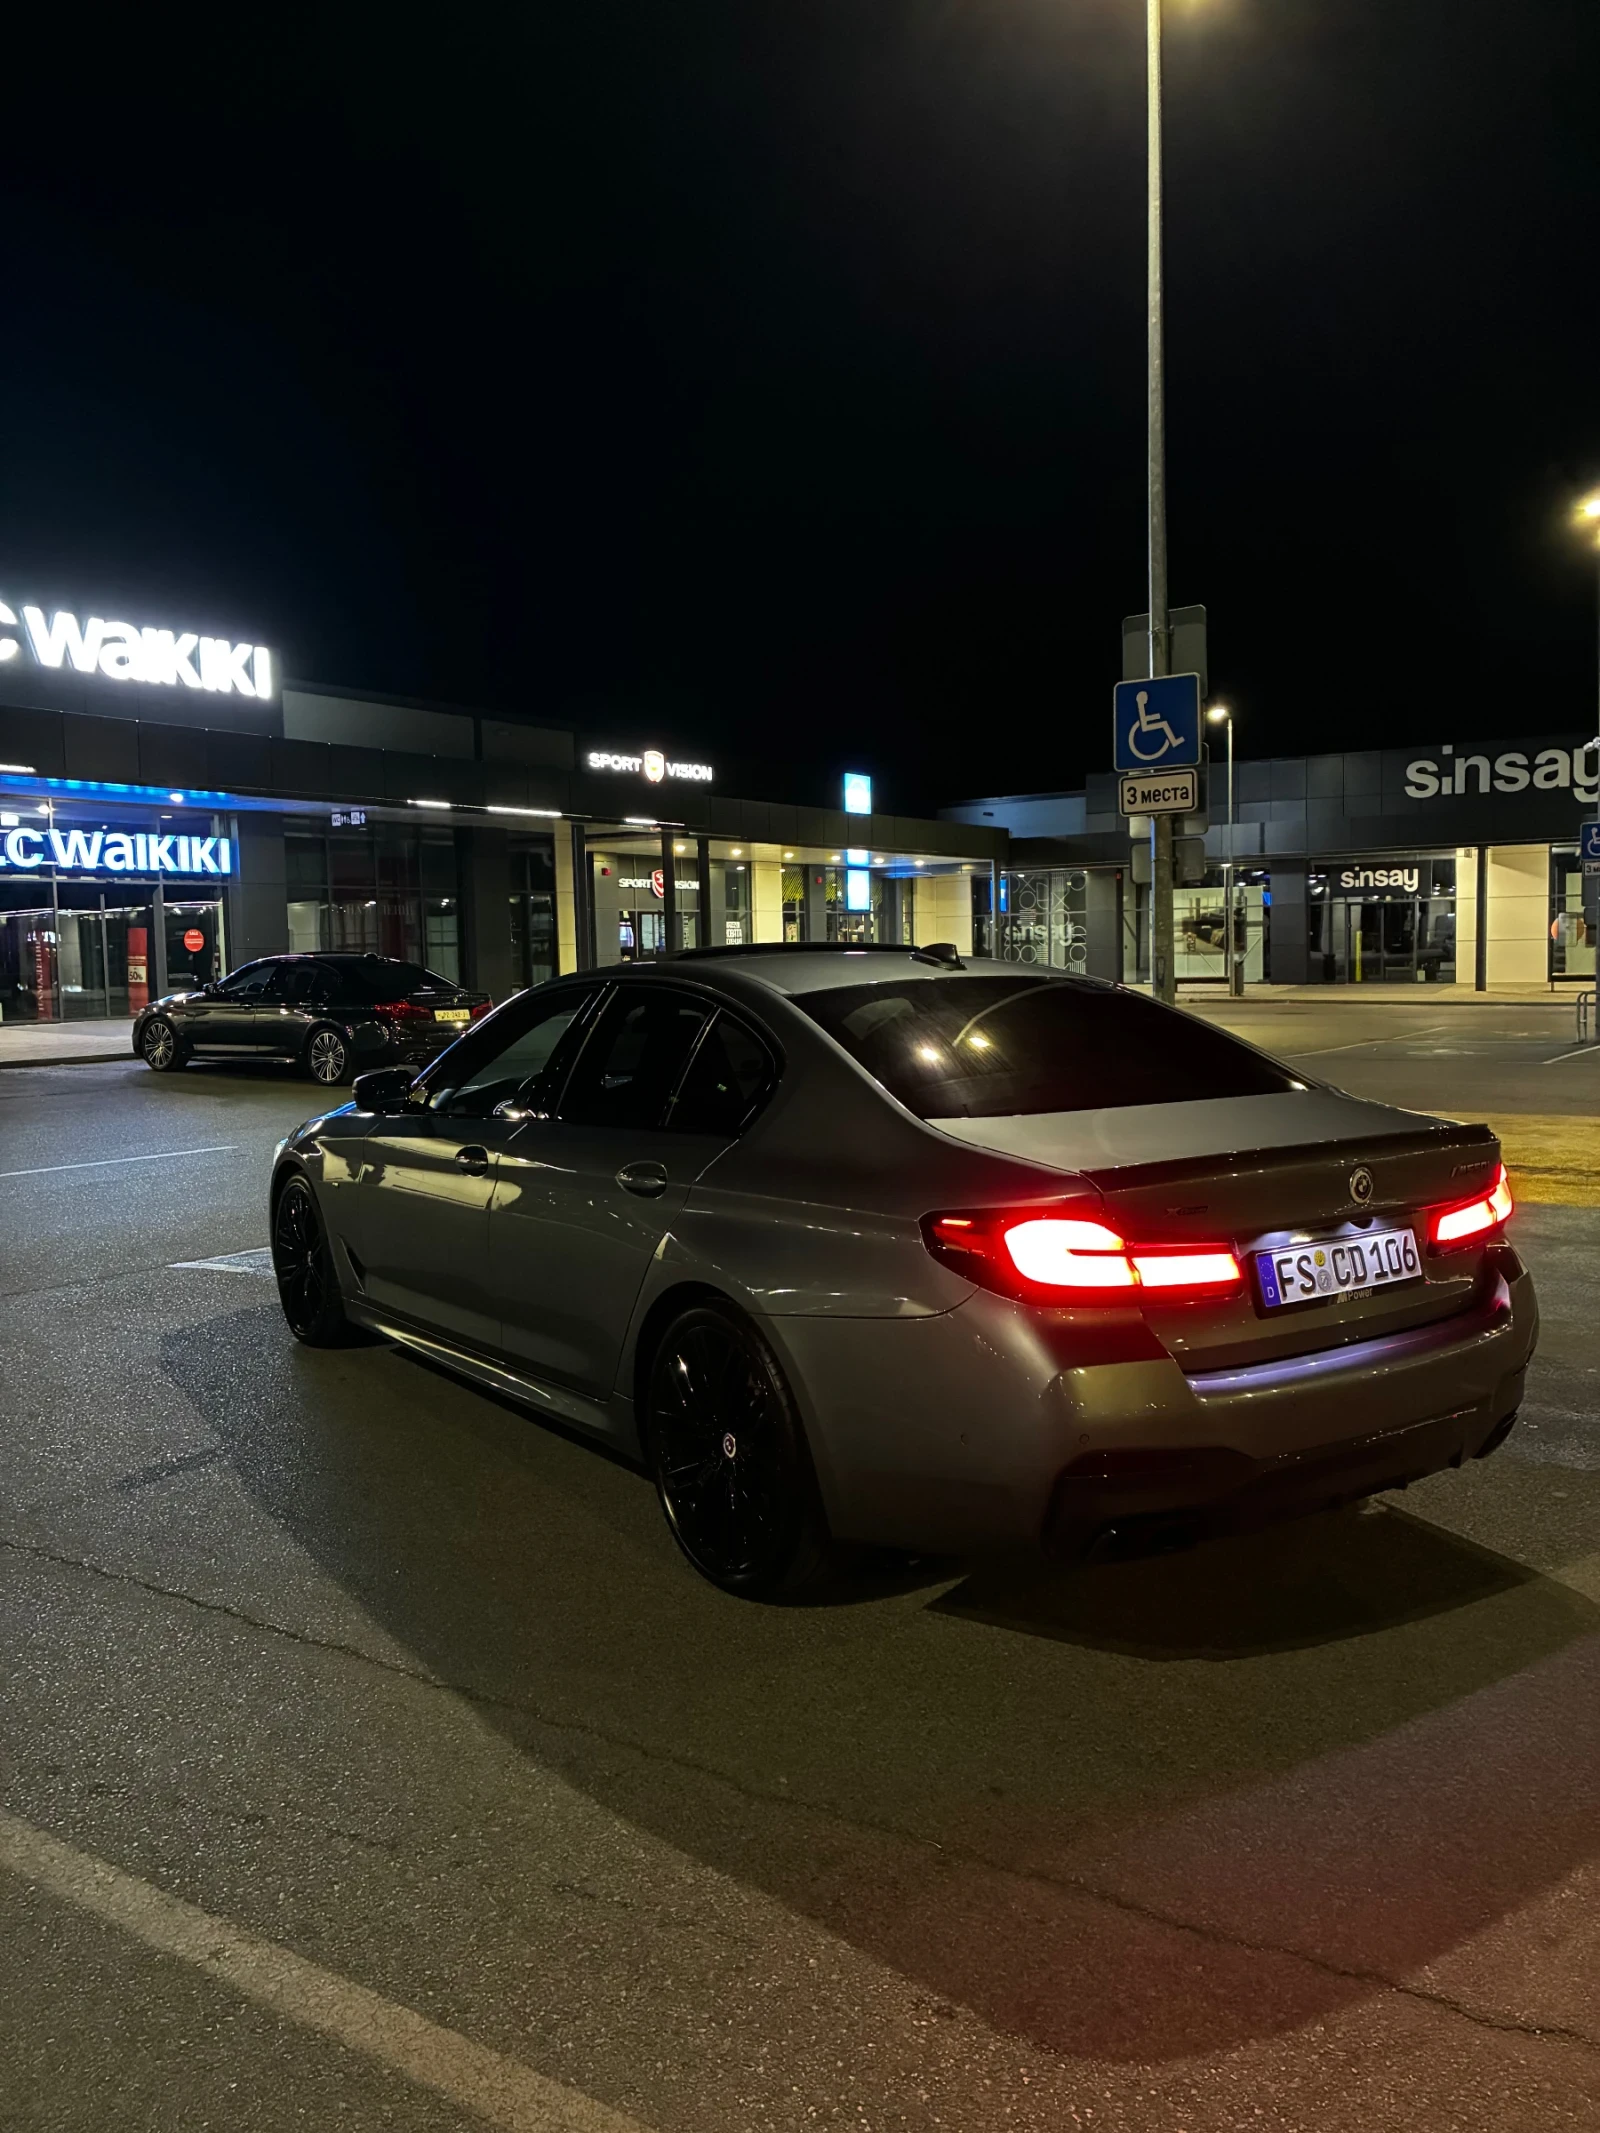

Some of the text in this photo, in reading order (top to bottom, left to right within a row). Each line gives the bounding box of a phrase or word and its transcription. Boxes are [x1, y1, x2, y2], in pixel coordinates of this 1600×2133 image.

[588, 752, 713, 780] SPORT VISION
[1127, 786, 1189, 805] 3 места
[618, 878, 652, 888] SPORT
[1340, 866, 1419, 892] sinsay
[1276, 1236, 1416, 1298] FS CD 106
[1267, 1286, 1275, 1299] D
